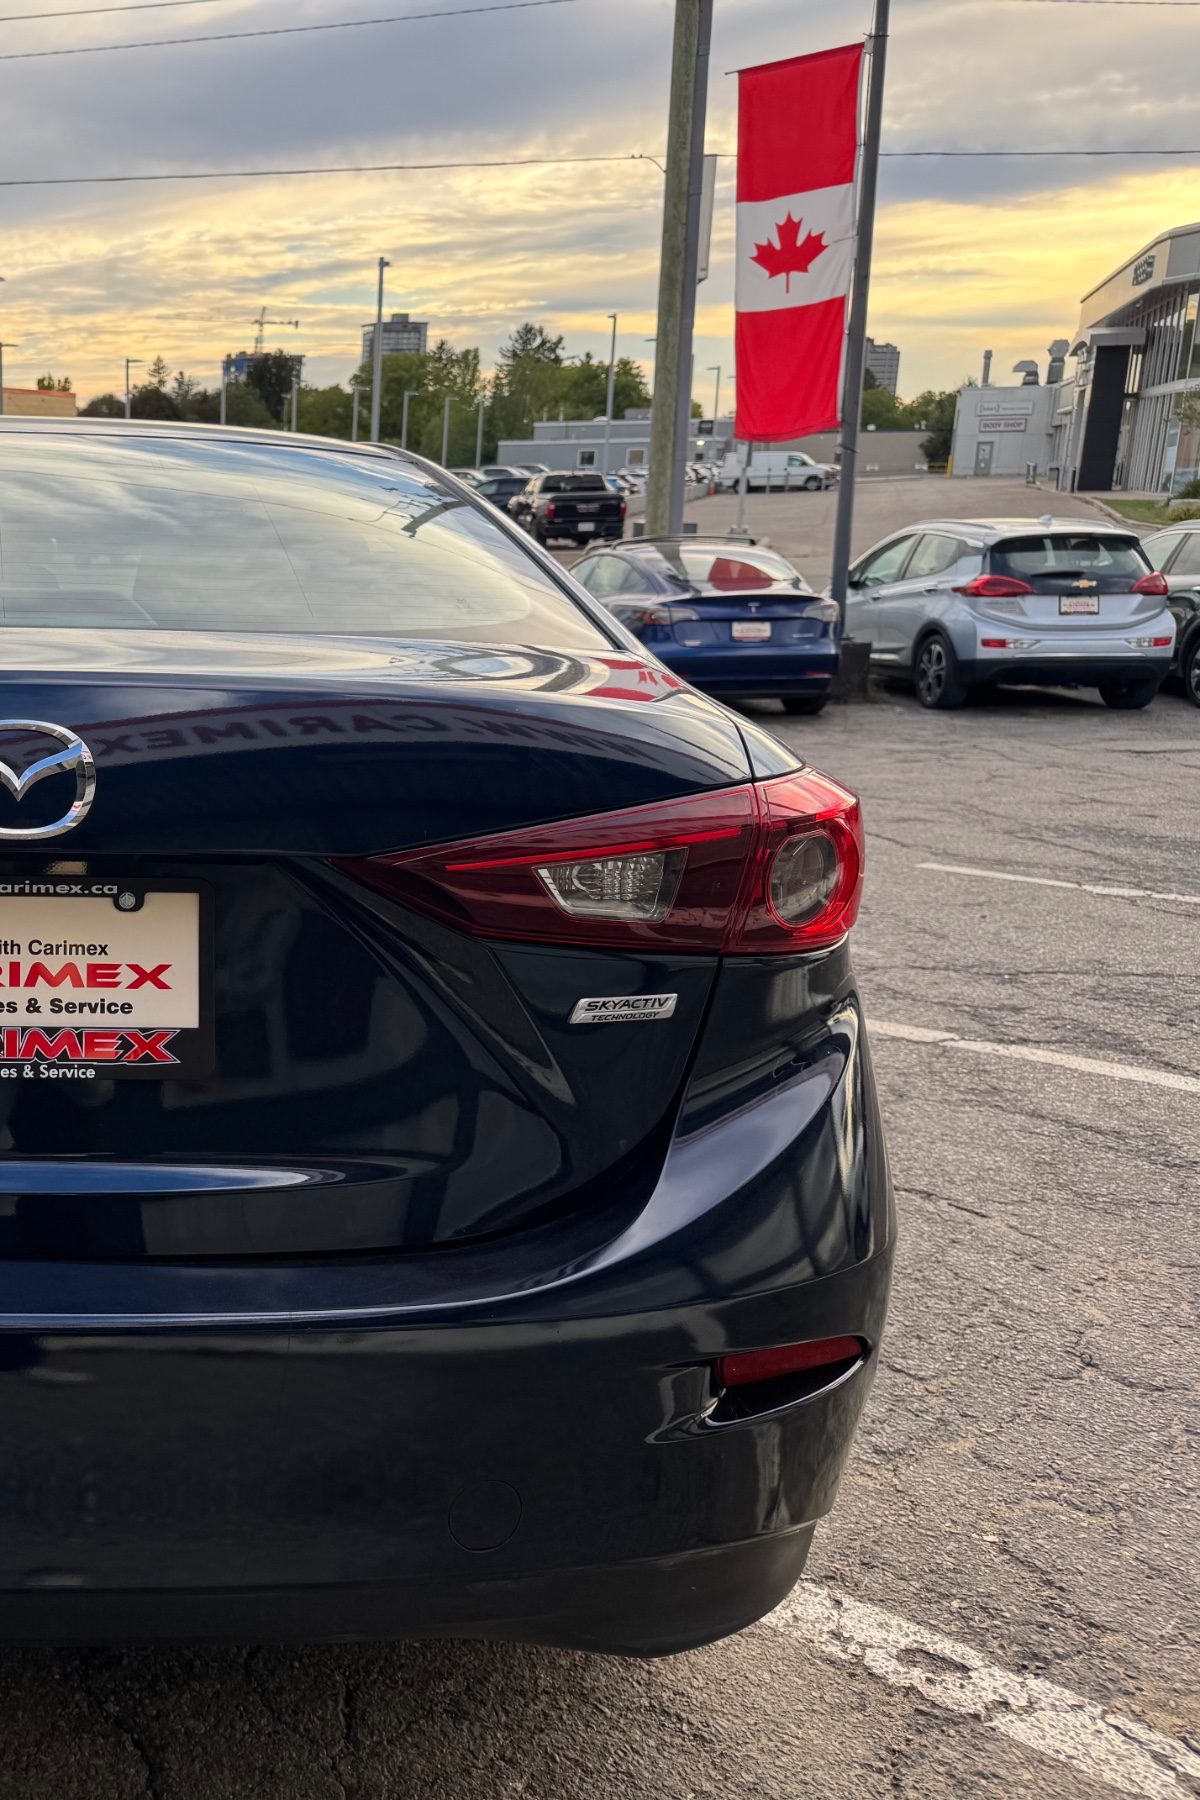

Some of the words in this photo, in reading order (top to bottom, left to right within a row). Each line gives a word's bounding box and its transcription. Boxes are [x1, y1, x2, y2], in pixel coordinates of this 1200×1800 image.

[1003, 421, 1023, 429] SHOP
[28, 939, 109, 956] Carimex
[25, 998, 42, 1014] &
[50, 998, 133, 1014] Service
[585, 997, 670, 1012] SKYACTIV
[591, 1011, 660, 1021] TECHNOLOGY
[22, 1064, 34, 1079] &
[39, 1064, 96, 1079] Service
